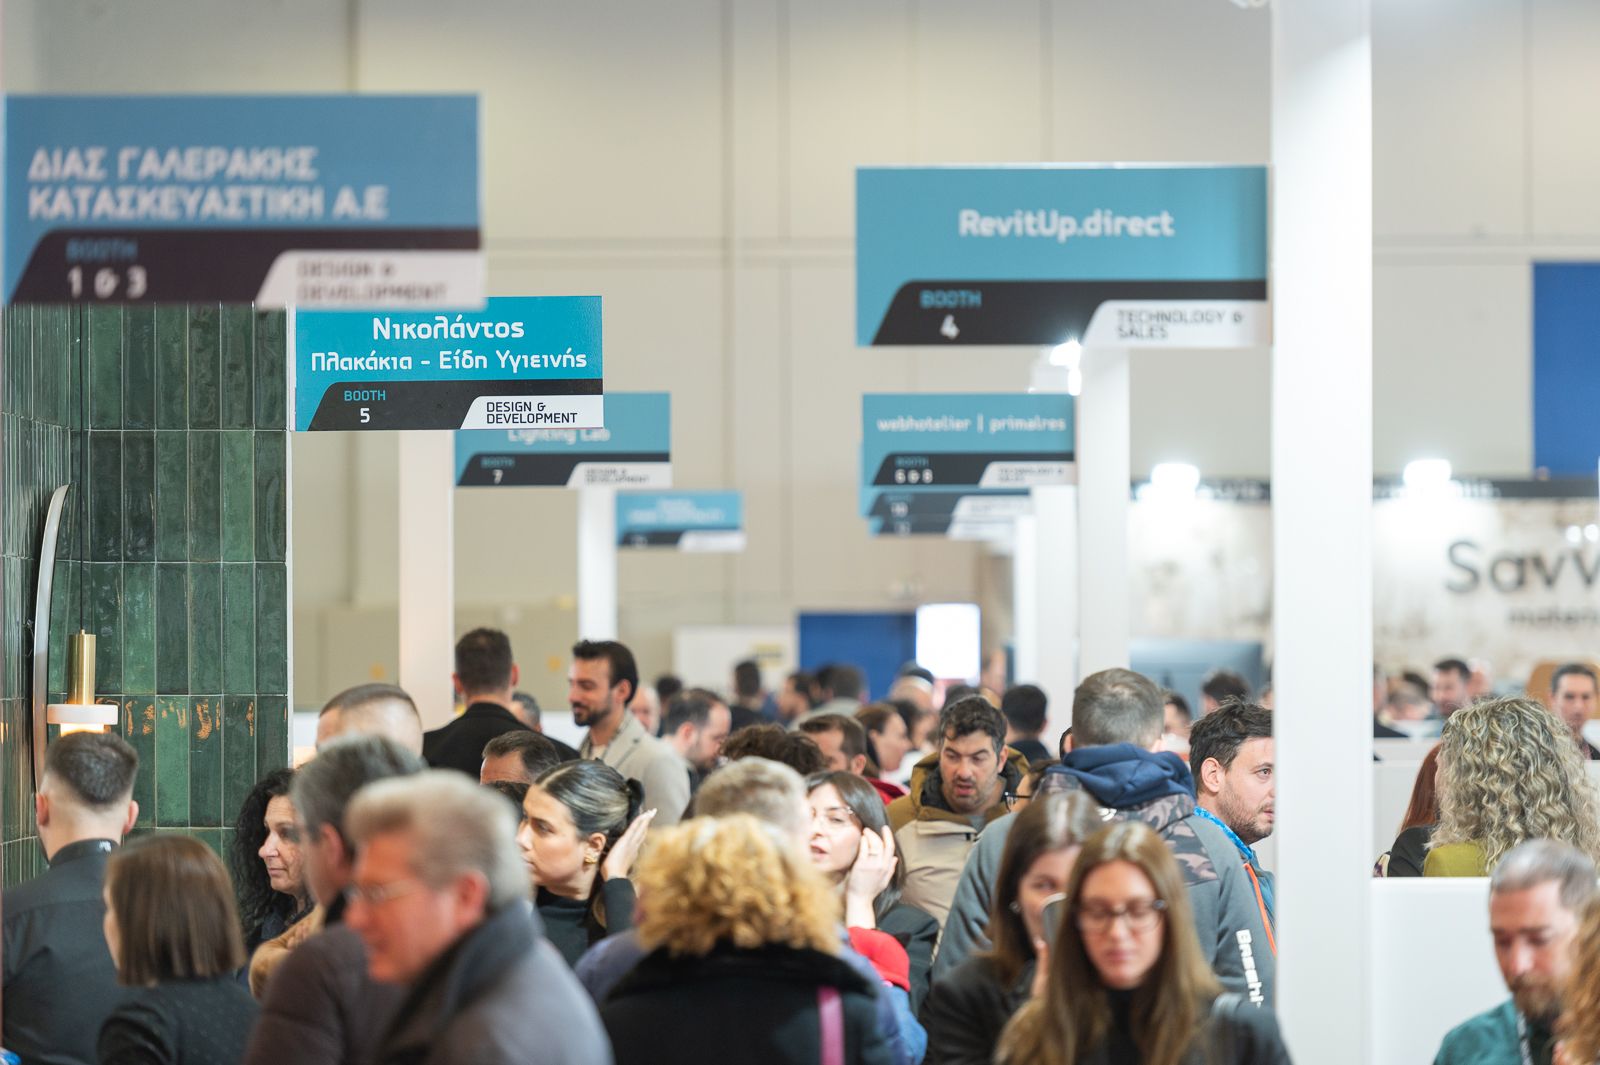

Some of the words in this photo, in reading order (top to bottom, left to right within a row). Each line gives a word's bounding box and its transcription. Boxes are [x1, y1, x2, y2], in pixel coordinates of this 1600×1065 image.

[29, 147, 107, 181] ΔΙΑΣ
[117, 147, 319, 181] ΓΑΛΕΡΑΚΗΣ
[29, 186, 325, 221] ΚΑΤΑΣΚΕΥΑΣΤΙΚΗ
[958, 209, 1176, 244] RevitUp.direct
[66, 239, 138, 262] BOOTH
[68, 267, 82, 299] 1
[94, 268, 119, 299] &
[126, 266, 147, 299] 3
[920, 290, 982, 309] BOOTH
[1117, 308, 1226, 325] TECHNOLOGY
[372, 313, 525, 340] Νικολάντος
[940, 314, 960, 340] 4
[1117, 324, 1168, 339] SALES
[311, 350, 413, 371] Πλακάκια
[439, 349, 488, 370] Είδη
[496, 347, 588, 373] Υγιεινής
[344, 390, 386, 402] BOOTH
[360, 408, 370, 423] 5
[486, 402, 532, 413] DESIGN
[537, 402, 546, 412] &
[486, 412, 578, 424] DEVELOPMENT
[877, 415, 972, 432] webhotelier
[508, 429, 576, 445] Lighting
[580, 429, 611, 441] Lab
[480, 457, 515, 468] BOOTH
